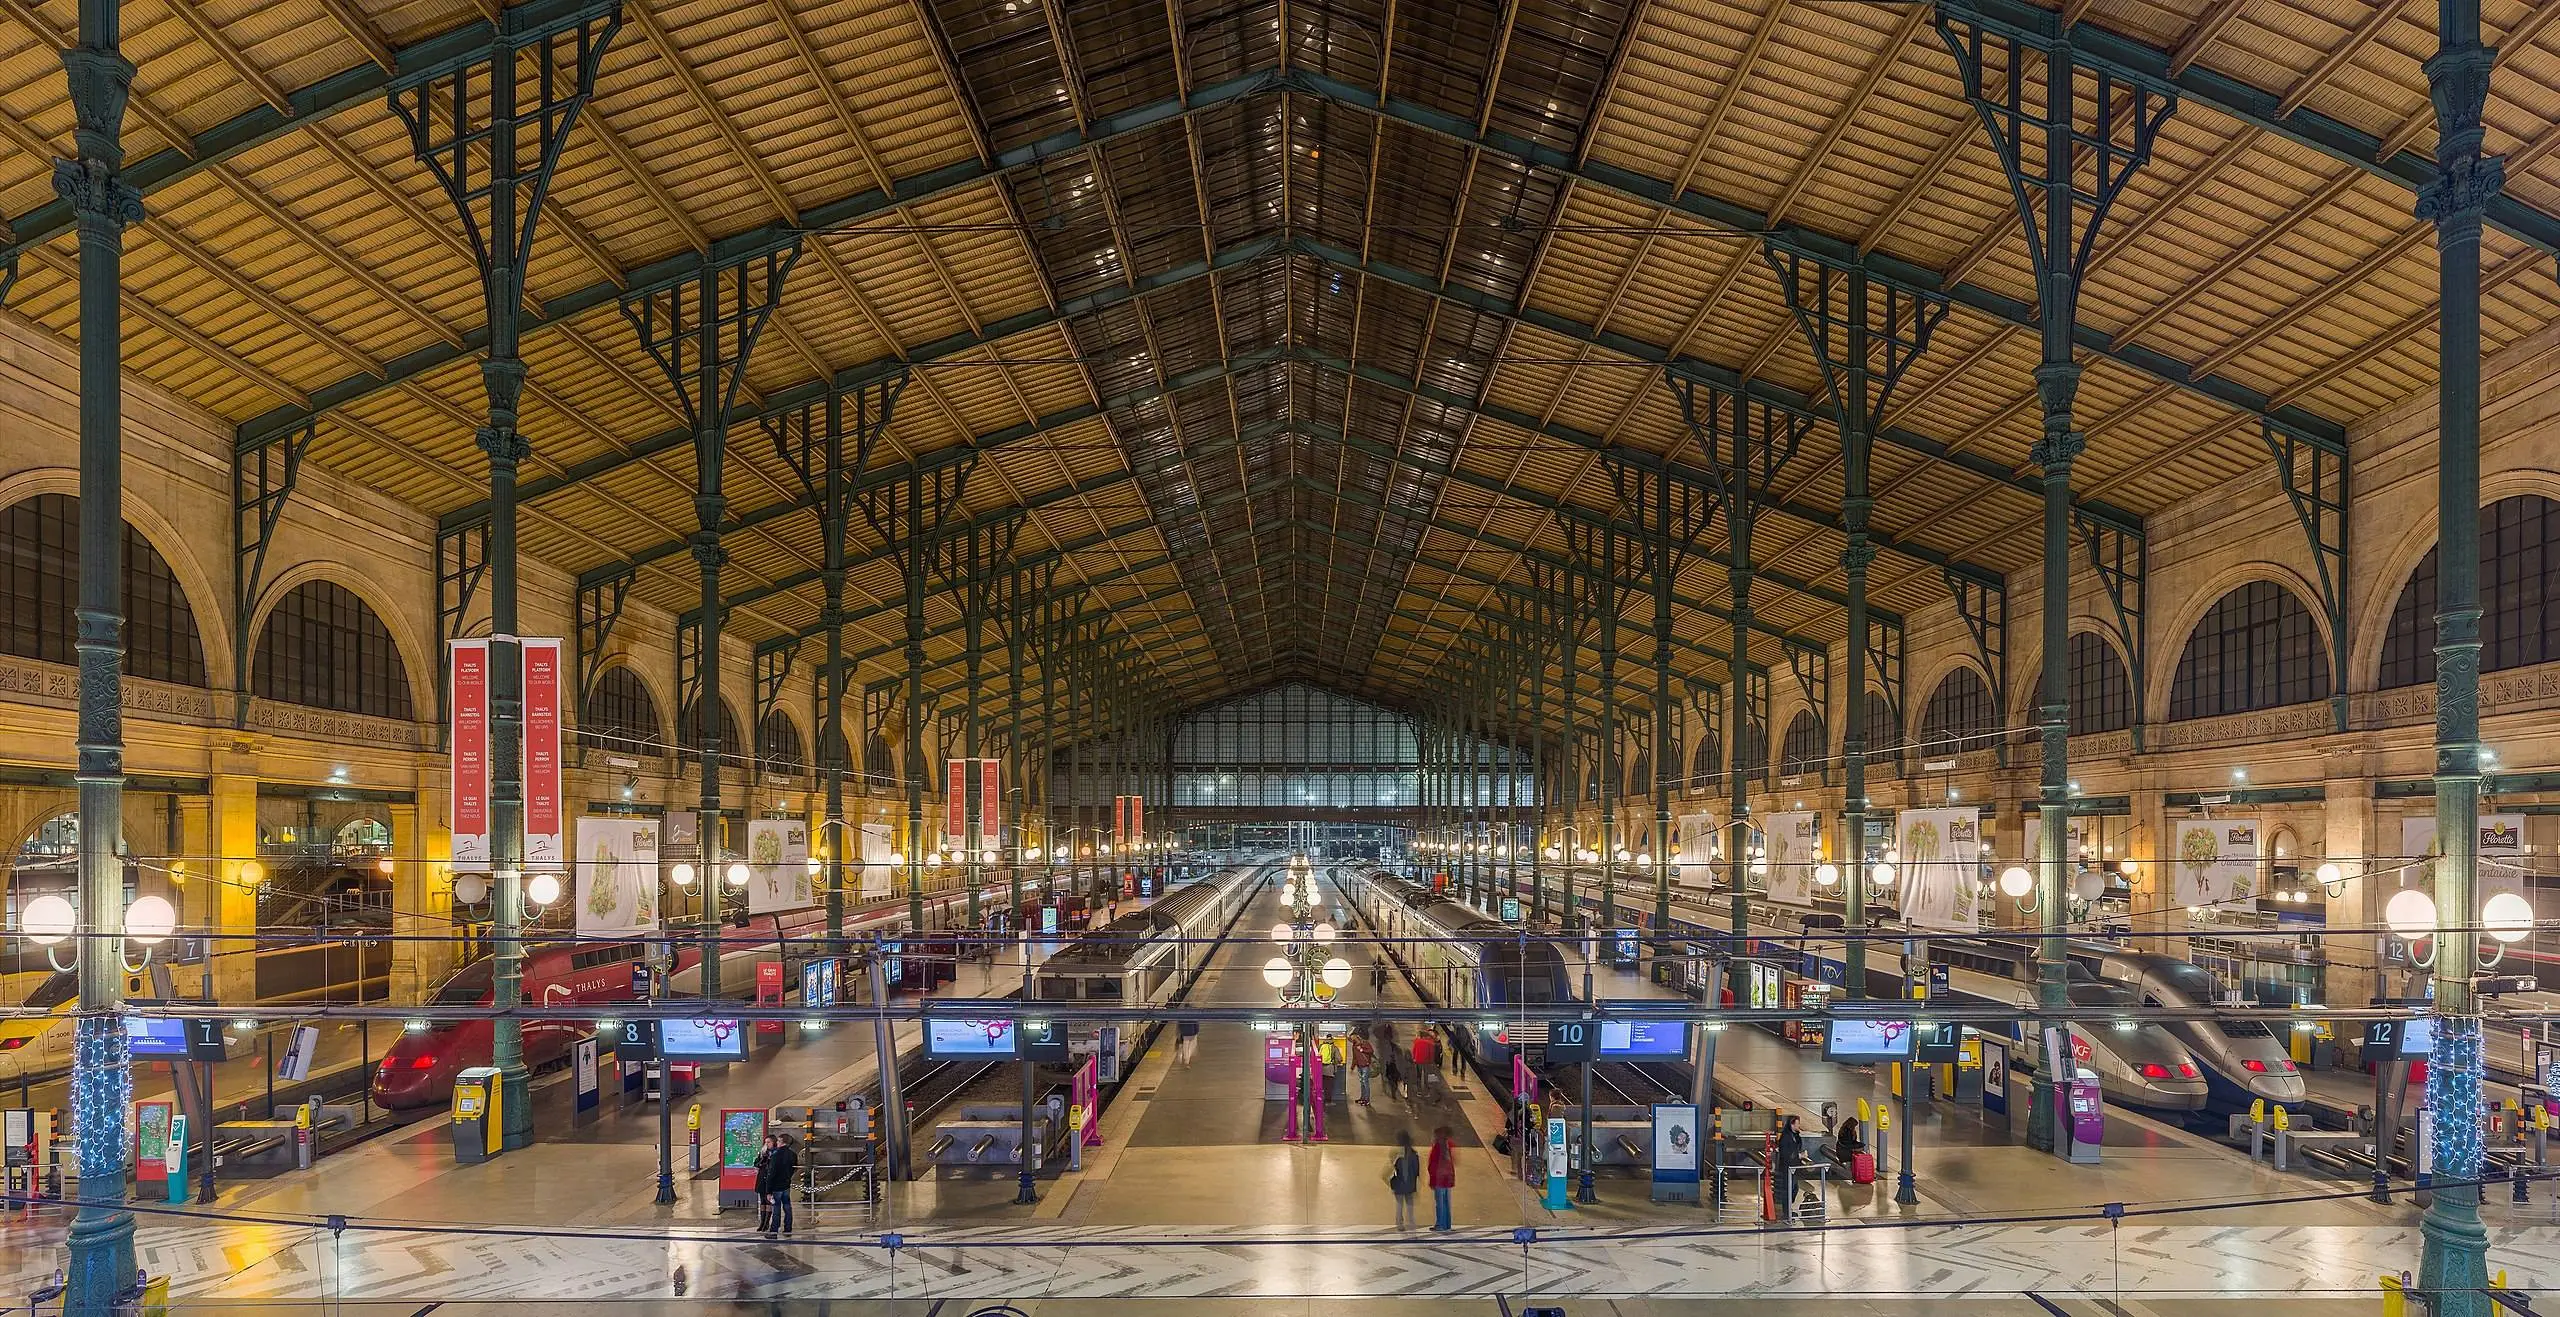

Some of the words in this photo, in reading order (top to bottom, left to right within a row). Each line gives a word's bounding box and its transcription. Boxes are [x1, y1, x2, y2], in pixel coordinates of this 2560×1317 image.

[2482, 832, 2515, 845] Florette
[2479, 867, 2518, 878] antaisie
[186, 942, 196, 957] 7
[650, 943, 657, 958] 8
[2389, 942, 2404, 958] 12
[575, 978, 606, 993] THALYS
[201, 1024, 211, 1042] 7
[626, 1023, 639, 1042] 8
[1558, 1024, 1583, 1043] 10
[1932, 1025, 1953, 1044] 11
[2373, 1022, 2392, 1042] 12
[2071, 1042, 2091, 1057] NCF
